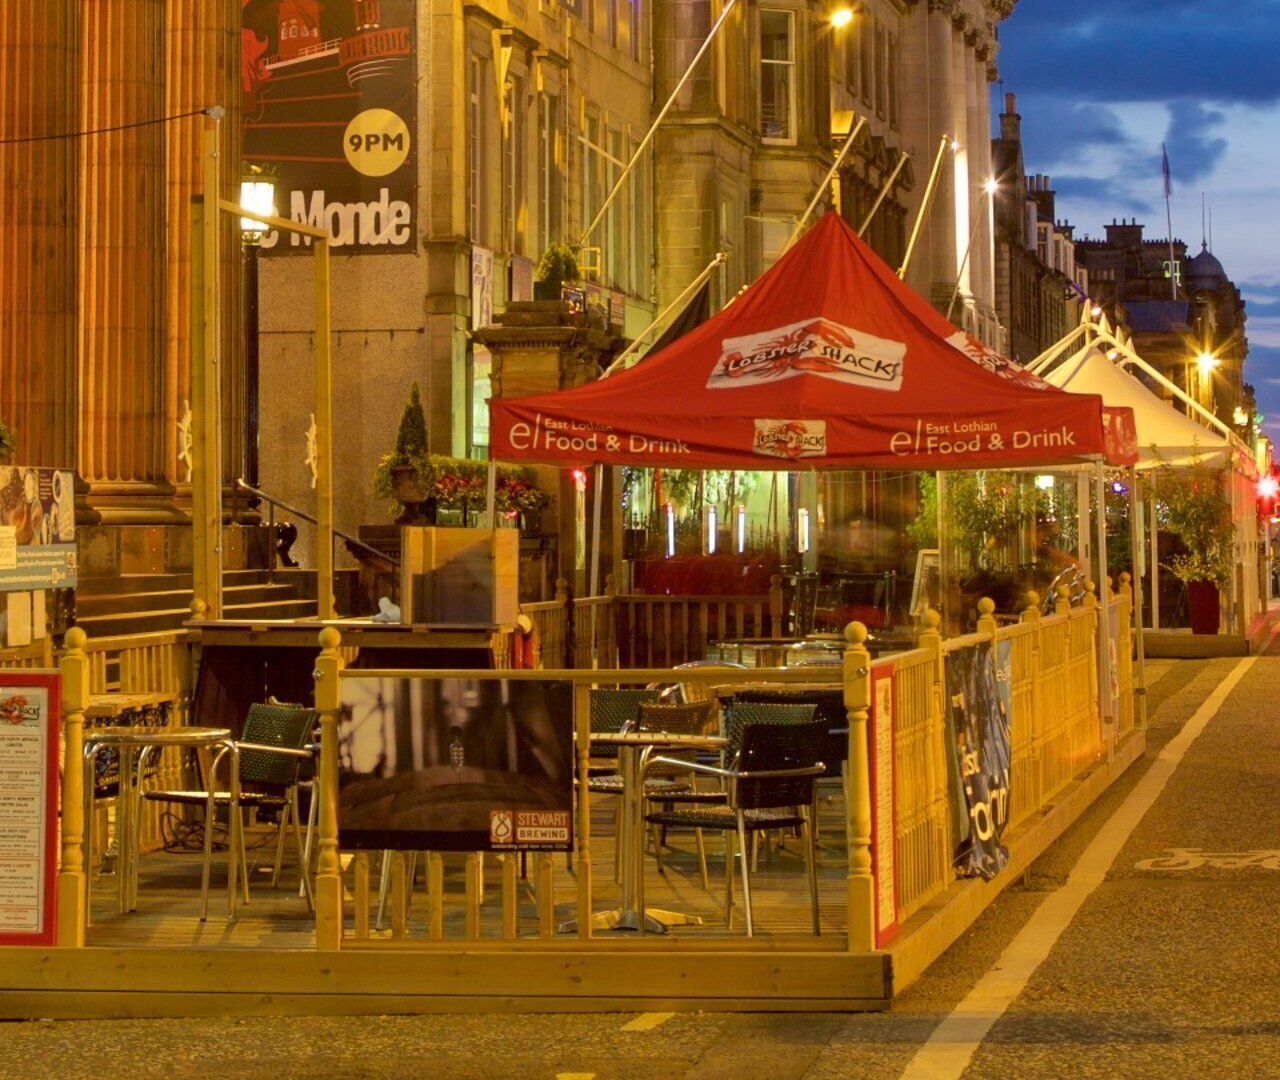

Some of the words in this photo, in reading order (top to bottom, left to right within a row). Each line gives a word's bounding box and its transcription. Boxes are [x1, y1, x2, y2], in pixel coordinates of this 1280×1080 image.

[349, 133, 403, 152] 9PM
[290, 187, 411, 248] Monde
[727, 339, 809, 372] LOBSTER
[545, 418, 568, 431] East
[926, 423, 950, 435] East
[954, 421, 997, 434] Lothian
[546, 431, 598, 451] Food
[605, 434, 621, 452] &
[630, 435, 691, 454] Drink
[927, 433, 980, 455] Food
[988, 433, 1004, 450] &
[1013, 426, 1076, 449] Drink
[518, 812, 568, 826] STEWART
[520, 829, 565, 839] BREWING
